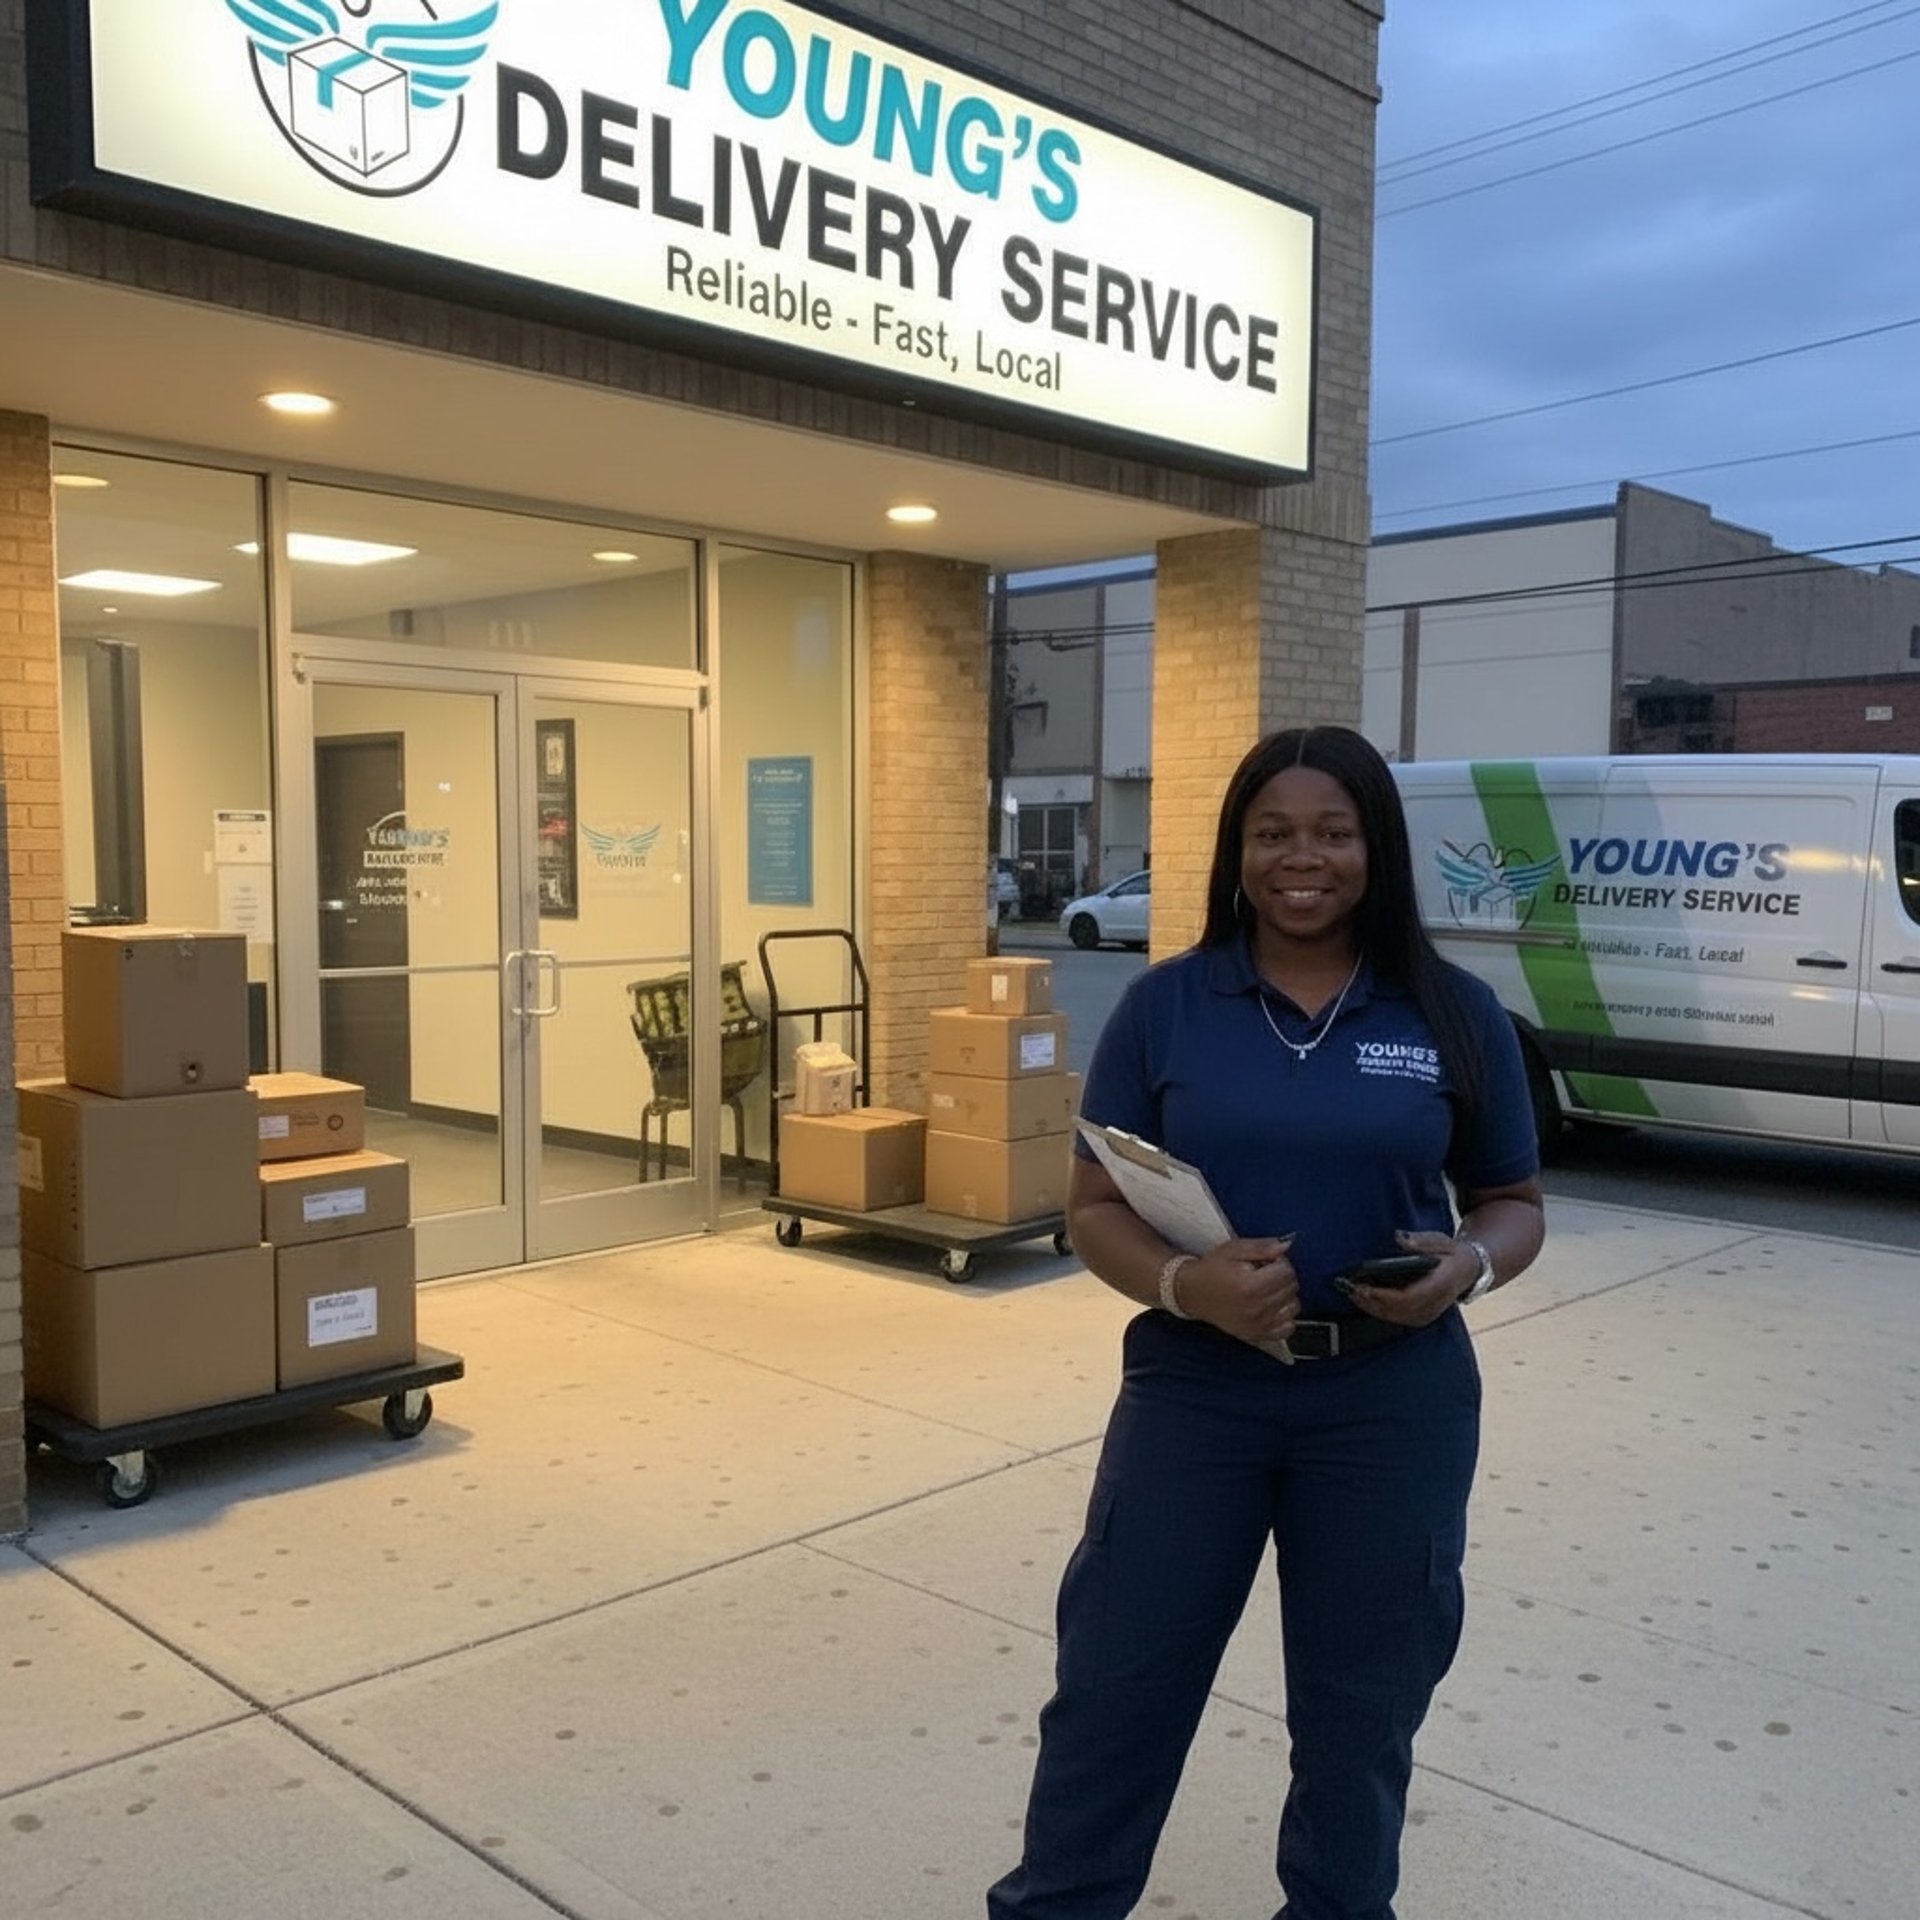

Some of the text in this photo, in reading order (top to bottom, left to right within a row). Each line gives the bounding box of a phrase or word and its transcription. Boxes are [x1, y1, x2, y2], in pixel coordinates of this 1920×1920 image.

[658, 0, 1081, 223] YOUNG'S
[497, 61, 1278, 394] DELIVERY SERVICE
[667, 245, 832, 331] Reliable
[873, 302, 958, 373] Fast,
[976, 330, 1060, 390] Local
[1554, 883, 1800, 916] DELIVERY SERVICE
[1569, 838, 1790, 881] YOUNG'S
